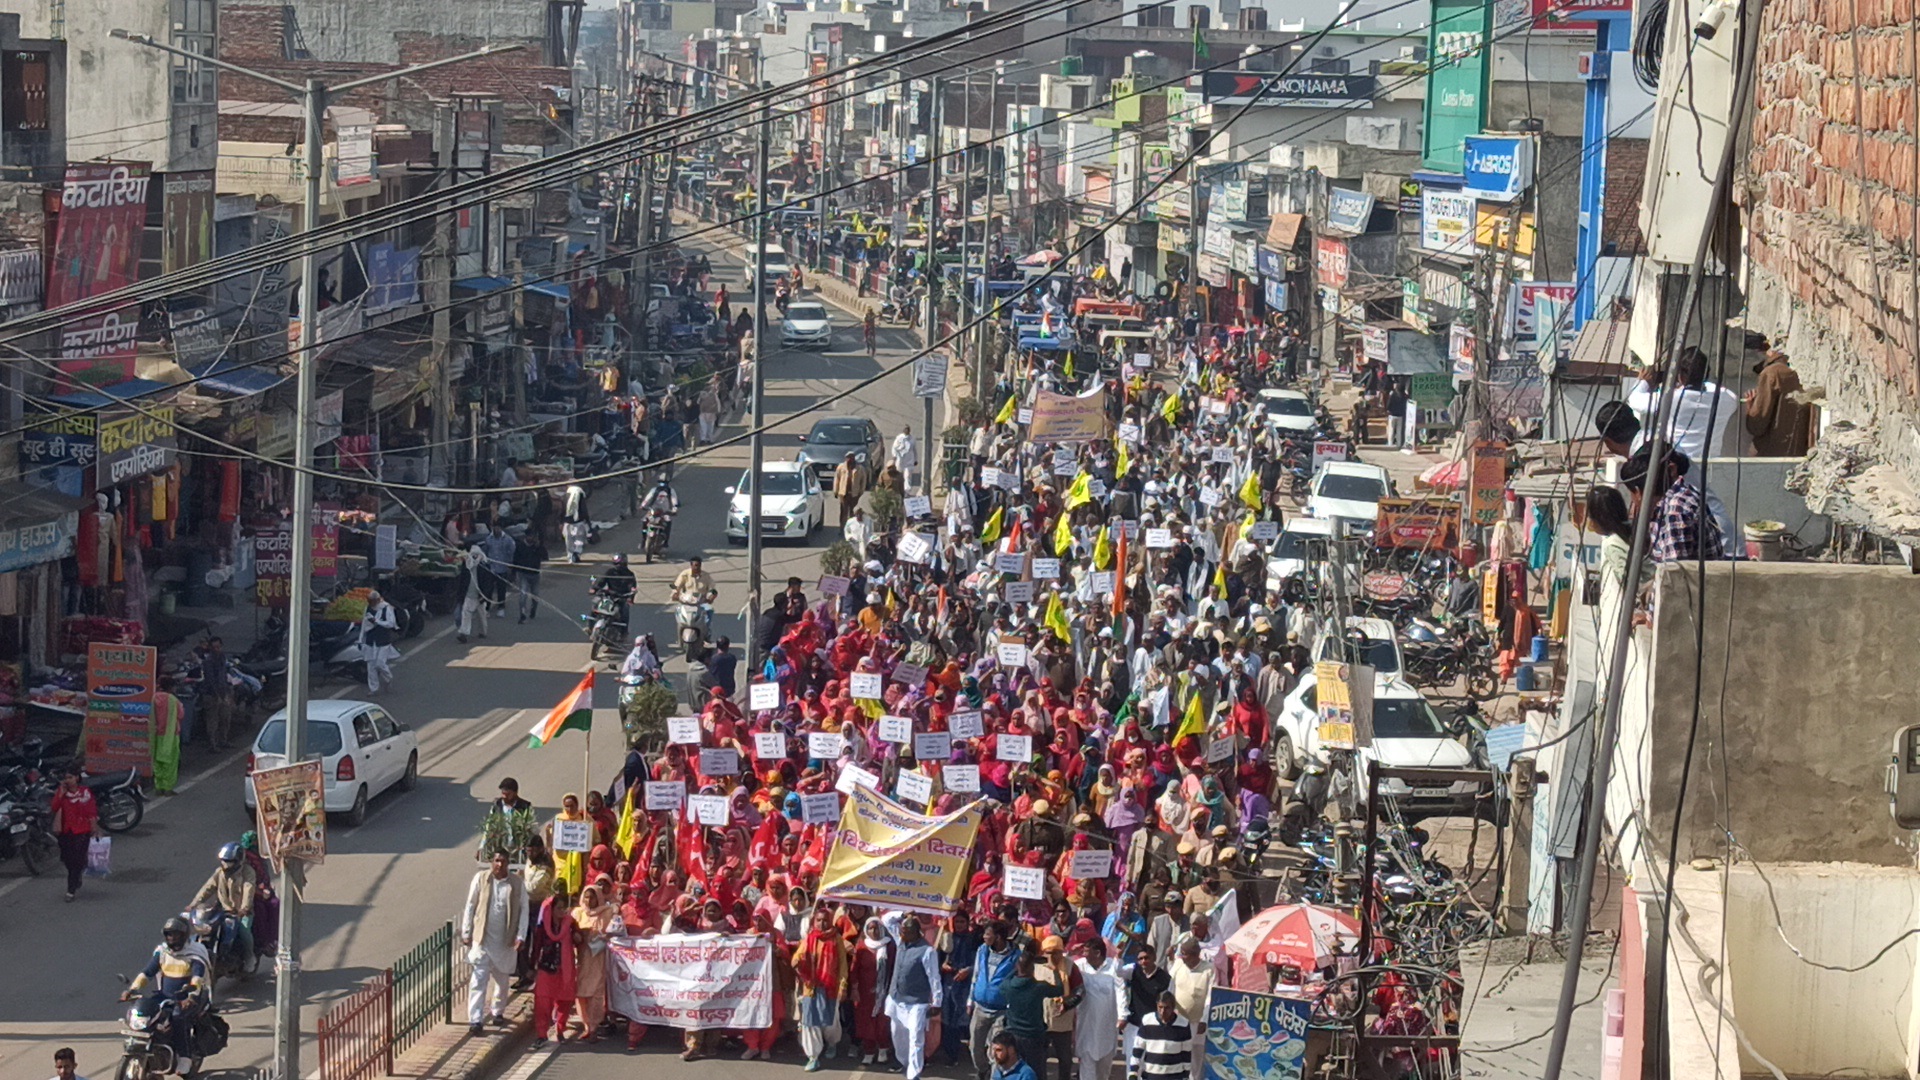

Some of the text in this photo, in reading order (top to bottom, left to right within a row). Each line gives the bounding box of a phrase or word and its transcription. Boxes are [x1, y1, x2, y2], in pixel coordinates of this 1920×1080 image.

[1259, 79, 1348, 95] YOKOHAMA
[62, 166, 150, 209] कटारिया
[62, 312, 138, 360] कटारिया
[101, 401, 175, 454] कटारिया
[49, 436, 66, 458] ही
[70, 443, 95, 465] सूट
[1210, 994, 1251, 1022] गायत्री
[1254, 996, 1273, 1035] शू
